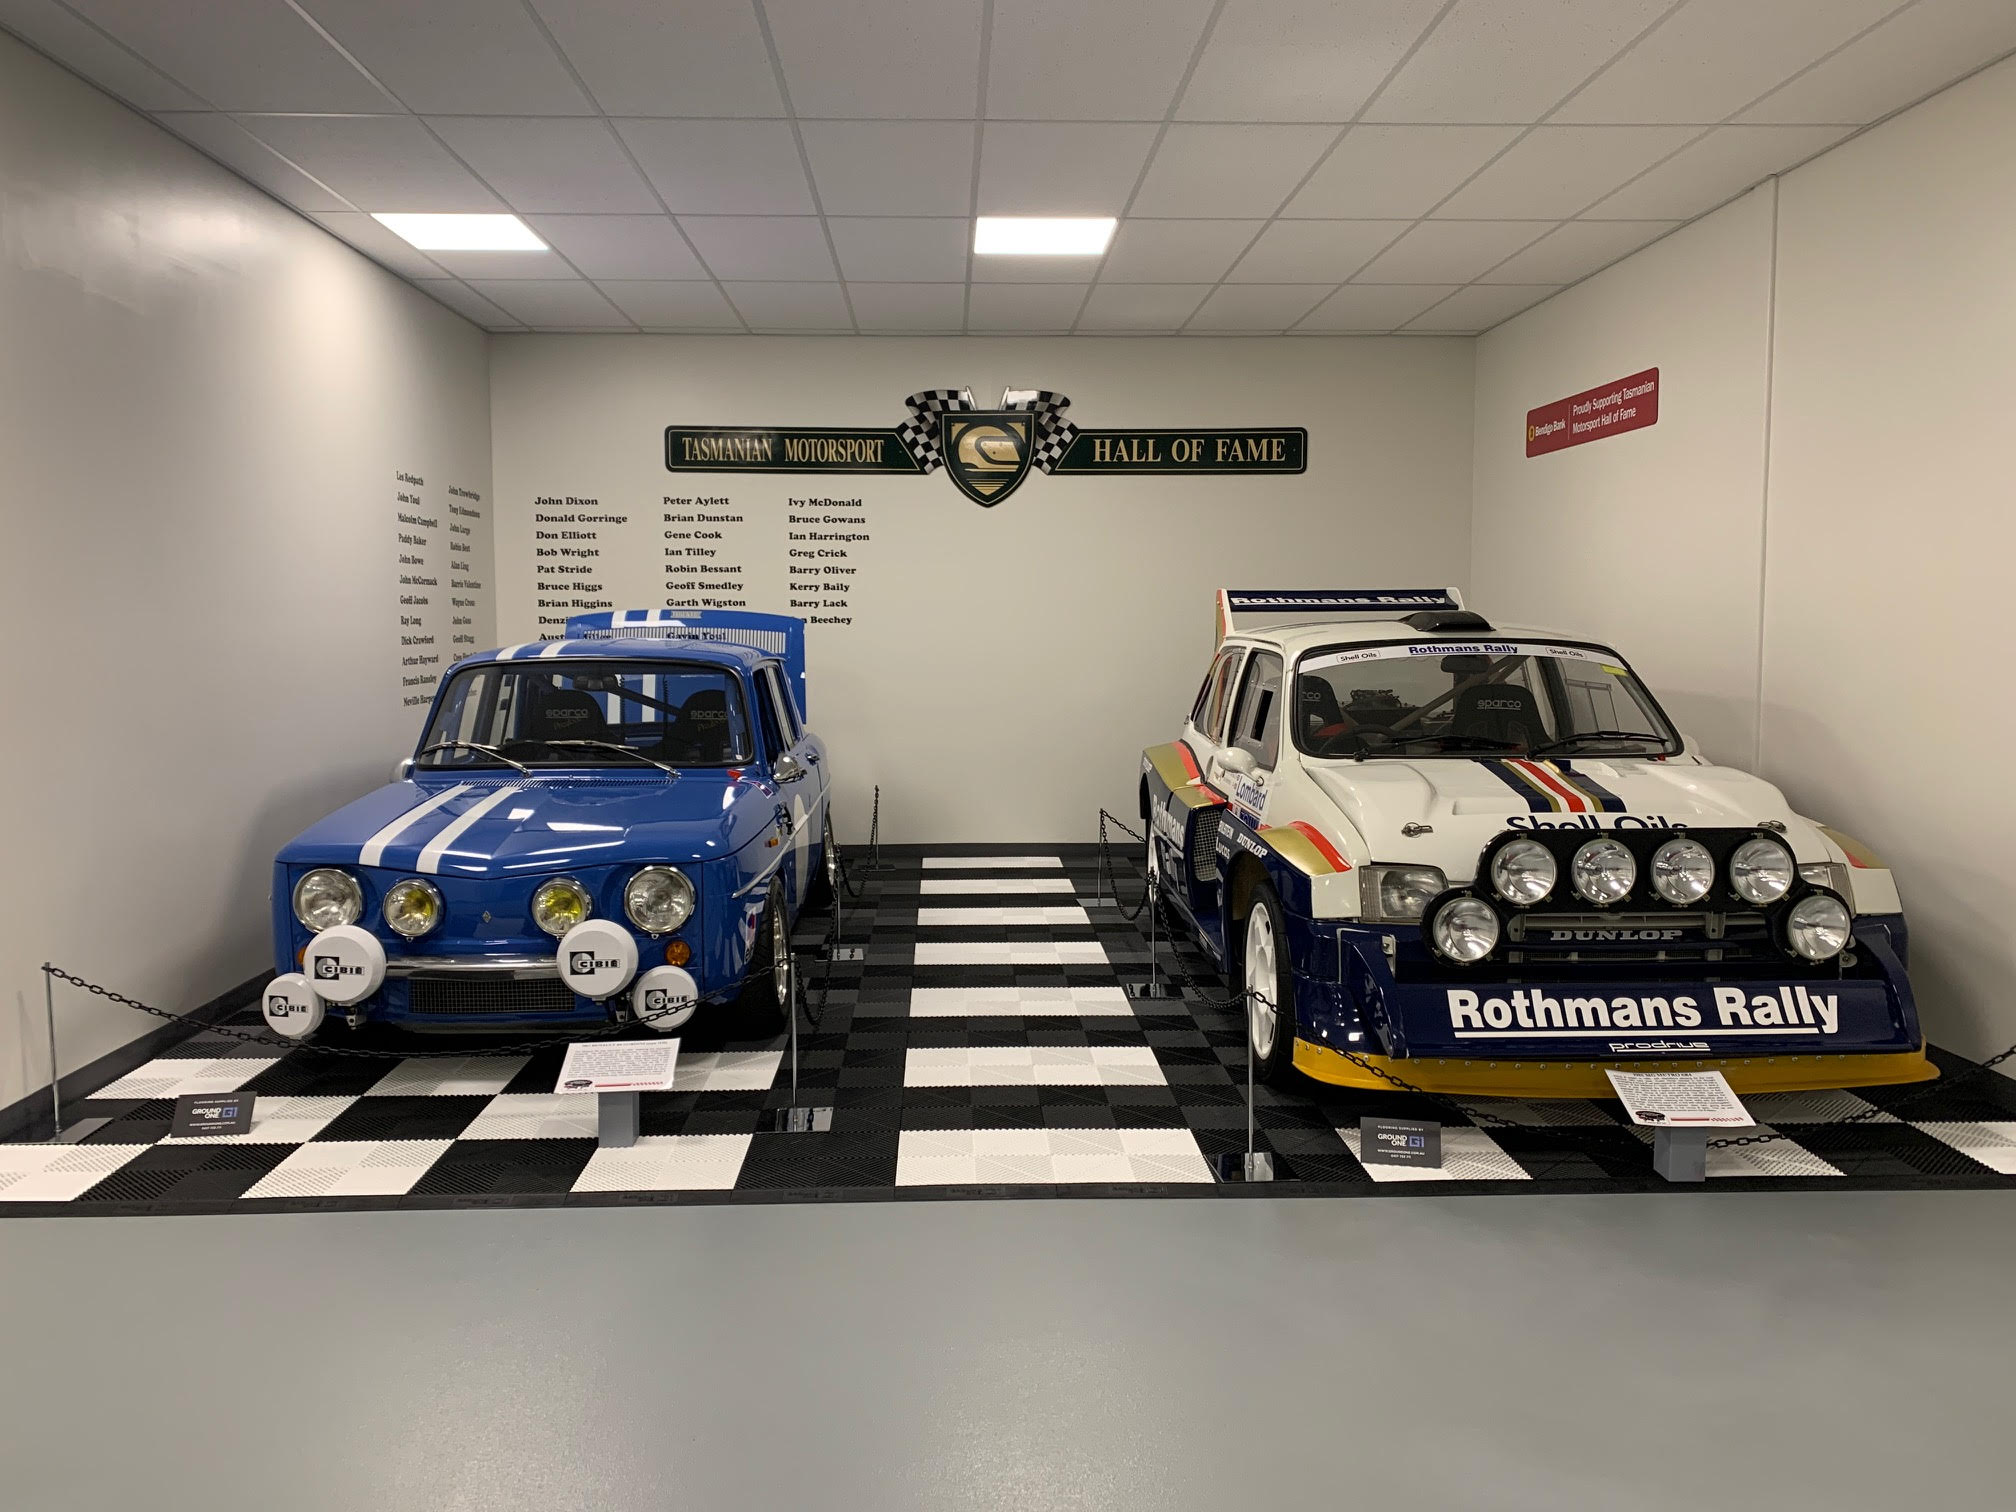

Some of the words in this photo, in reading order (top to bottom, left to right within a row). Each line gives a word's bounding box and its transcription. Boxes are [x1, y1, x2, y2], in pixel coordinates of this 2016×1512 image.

[1573, 403, 1592, 416] Proudly
[1593, 389, 1623, 411] Supporting
[1623, 380, 1655, 399] Tasmanian
[1573, 417, 1601, 434] Motorsport
[1601, 413, 1613, 425] Hall
[1613, 411, 1619, 422] of
[1620, 406, 1637, 420] Fame
[1535, 425, 1553, 437] Bendigo
[1553, 418, 1566, 432] Bank
[681, 436, 773, 462] TASMANIAN
[784, 438, 885, 463] MOTORSPORT
[1092, 438, 1162, 463] HALL
[1170, 438, 1205, 463] OF
[1215, 437, 1286, 463] FAME
[397, 491, 409, 503] John
[534, 496, 563, 507] John
[565, 496, 599, 507] Dixon
[662, 496, 693, 507] Peter
[694, 496, 730, 508] Aylett
[788, 497, 807, 509] Ivy
[808, 497, 863, 508] McDonald
[397, 511, 417, 525] Malcolm
[417, 515, 438, 528] Campbell
[535, 513, 576, 524] Donald
[577, 513, 628, 526] Gorringe
[663, 513, 695, 524] Brian
[696, 513, 744, 524] Dunstan
[788, 514, 821, 525] Bruce
[822, 514, 866, 525] Gowans
[398, 532, 412, 546] Paddy
[413, 535, 427, 546] Baker
[535, 530, 558, 541] Don
[559, 530, 597, 541] Elliott
[663, 530, 692, 541] Gene
[693, 530, 723, 541] Cook
[788, 531, 807, 542] Ian
[808, 531, 870, 544] Harrington
[399, 553, 411, 565] John
[536, 547, 558, 558] Bob
[559, 547, 600, 560] Wright
[664, 547, 683, 558] Ian
[684, 547, 717, 559] Tilley
[788, 548, 816, 561] Greg
[816, 548, 848, 559] Crick
[536, 564, 556, 575] Pat
[557, 564, 593, 575] Stride
[665, 564, 698, 575] Robin
[700, 563, 742, 575] Bessant
[789, 565, 822, 577] Barry
[822, 565, 857, 576] Oliver
[400, 574, 411, 585] John
[411, 575, 438, 586] McCormack
[537, 581, 570, 592] Bruce
[572, 581, 603, 594] Higgs
[665, 581, 696, 592] Geoff
[697, 580, 744, 593] Smedley
[789, 582, 821, 594] Kerry
[822, 582, 850, 594] Baily
[400, 594, 413, 605] Geoff
[537, 598, 569, 608] Brian
[571, 598, 613, 610] Higgins
[665, 597, 699, 608] Garth
[700, 597, 747, 610] Wigston
[789, 599, 821, 611] Barry
[822, 599, 848, 609] Lack
[1231, 597, 1370, 606] Rothmans
[1376, 596, 1446, 604] Rally
[400, 615, 410, 627] Ray
[410, 615, 422, 627] Long
[810, 616, 852, 626] Beechey
[401, 635, 412, 646] Dick
[412, 635, 434, 645] Crawford
[1408, 645, 1481, 655] Rothmans
[1483, 643, 1518, 654] Rally
[402, 656, 419, 667] Arthur
[1361, 652, 1378, 660] Oils
[402, 676, 419, 687] Francis
[403, 696, 420, 707] Neville
[1477, 699, 1522, 710] sparco
[1236, 775, 1268, 811] Lombard
[1236, 832, 1269, 859] DUNLOP
[1550, 929, 1683, 941] DUNLOP
[1446, 987, 1702, 1029] Rothmans
[1713, 986, 1839, 1034] Rally
[192, 1107, 222, 1115] GROUND
[1377, 1133, 1408, 1141] GROUND
[1391, 1139, 1407, 1147] ONE
